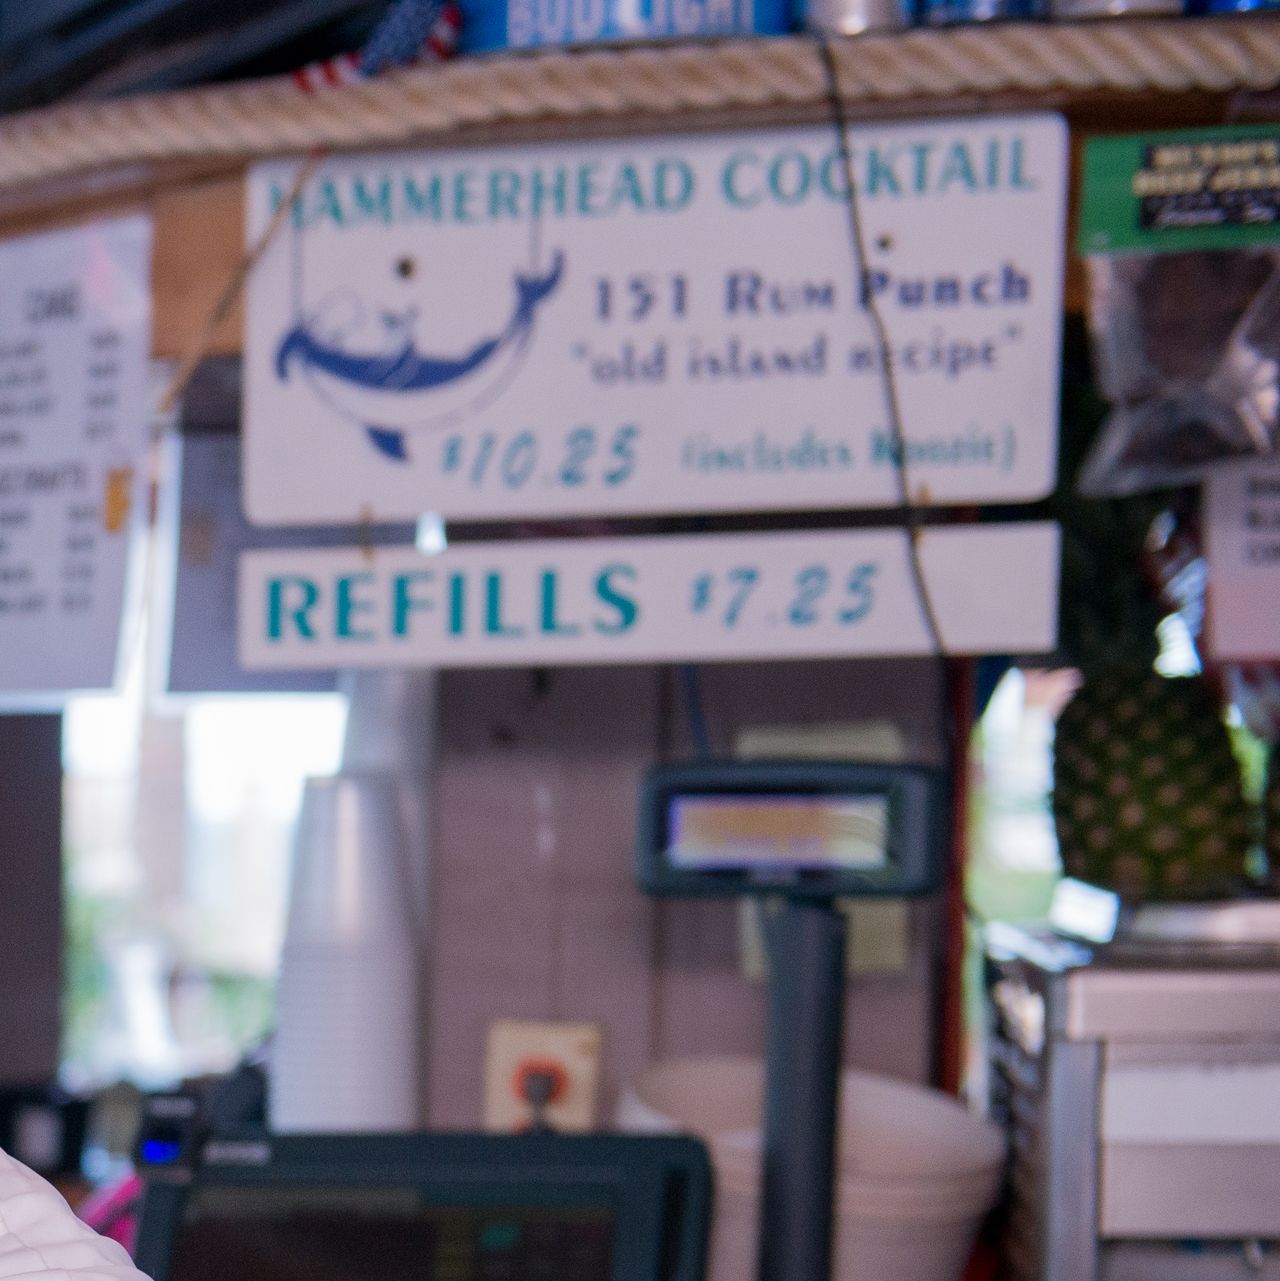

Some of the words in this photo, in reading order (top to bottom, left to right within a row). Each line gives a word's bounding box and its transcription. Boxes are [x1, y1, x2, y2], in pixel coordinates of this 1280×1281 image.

[267, 156, 694, 229] HAMMERHEAD
[721, 136, 1036, 208] COCKTAIL
[596, 270, 687, 321] 151
[859, 257, 1031, 310] Punch
[688, 333, 828, 379] island
[266, 563, 640, 642] REFILLS
